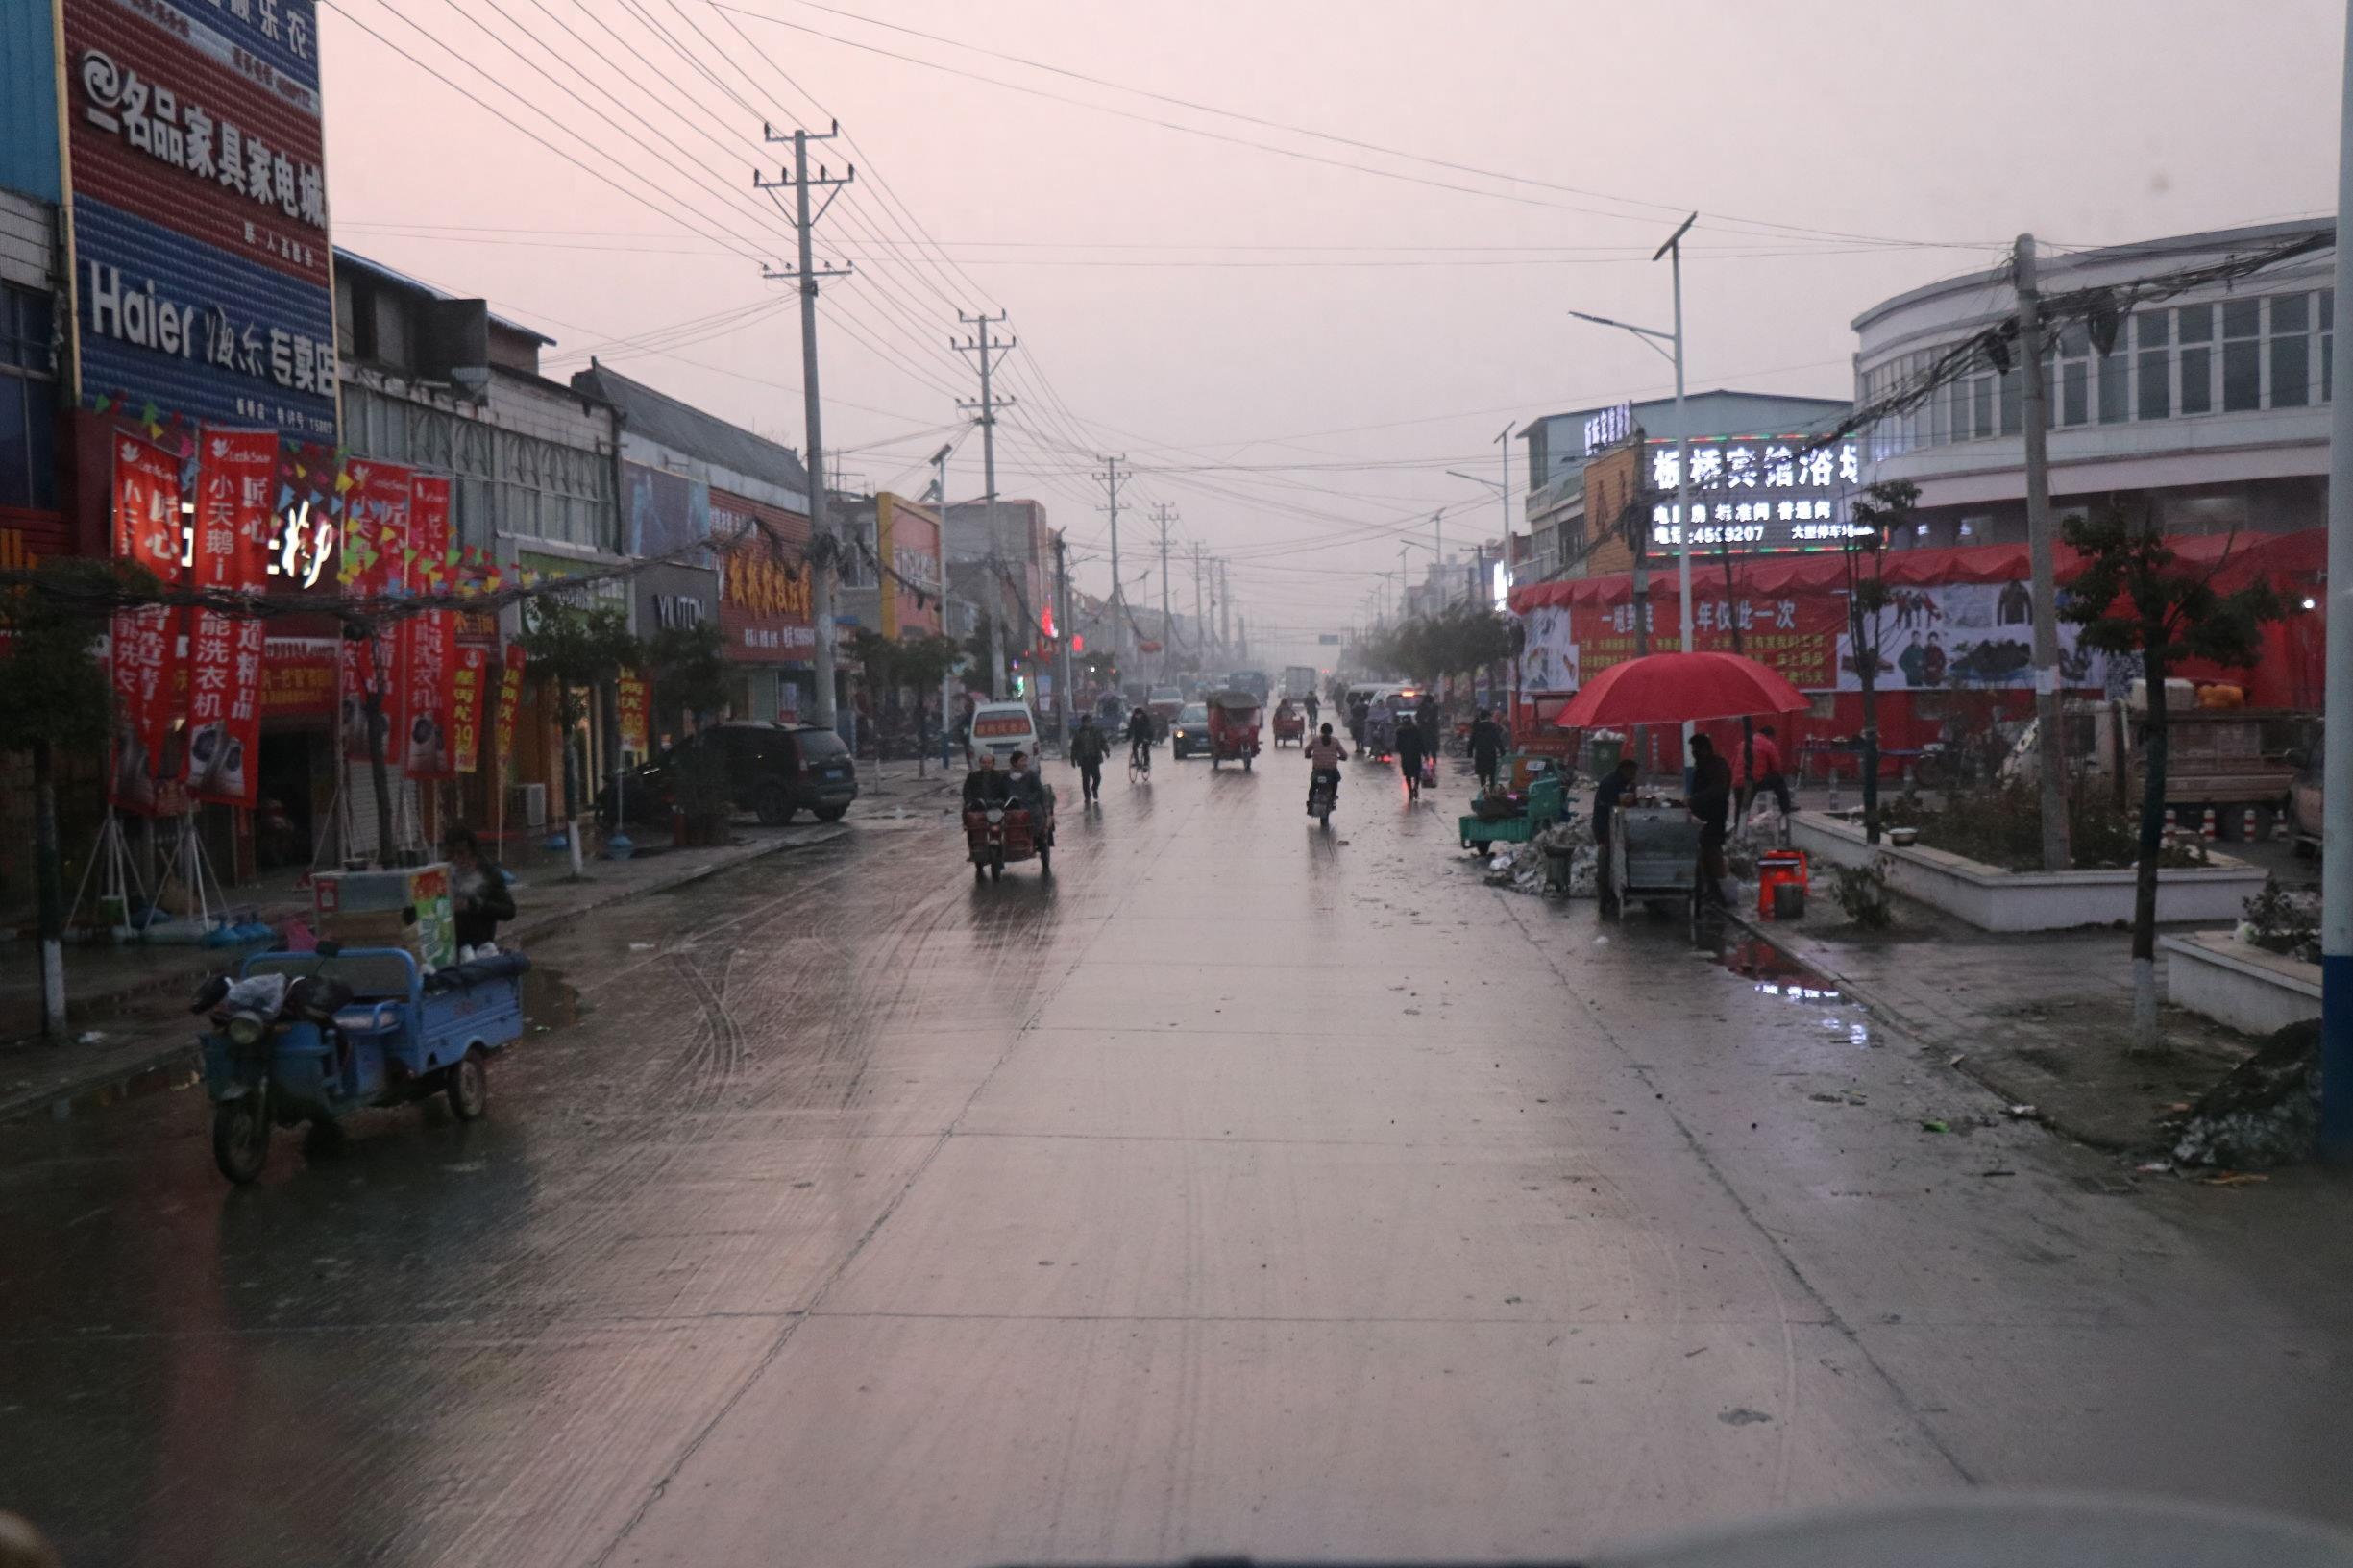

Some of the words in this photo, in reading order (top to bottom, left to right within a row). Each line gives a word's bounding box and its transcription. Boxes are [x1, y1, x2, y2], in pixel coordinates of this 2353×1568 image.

[121, 69, 326, 229] 名品家具家电城
[91, 260, 193, 359] Haier
[1679, 599, 1796, 632] 年仅此一次
